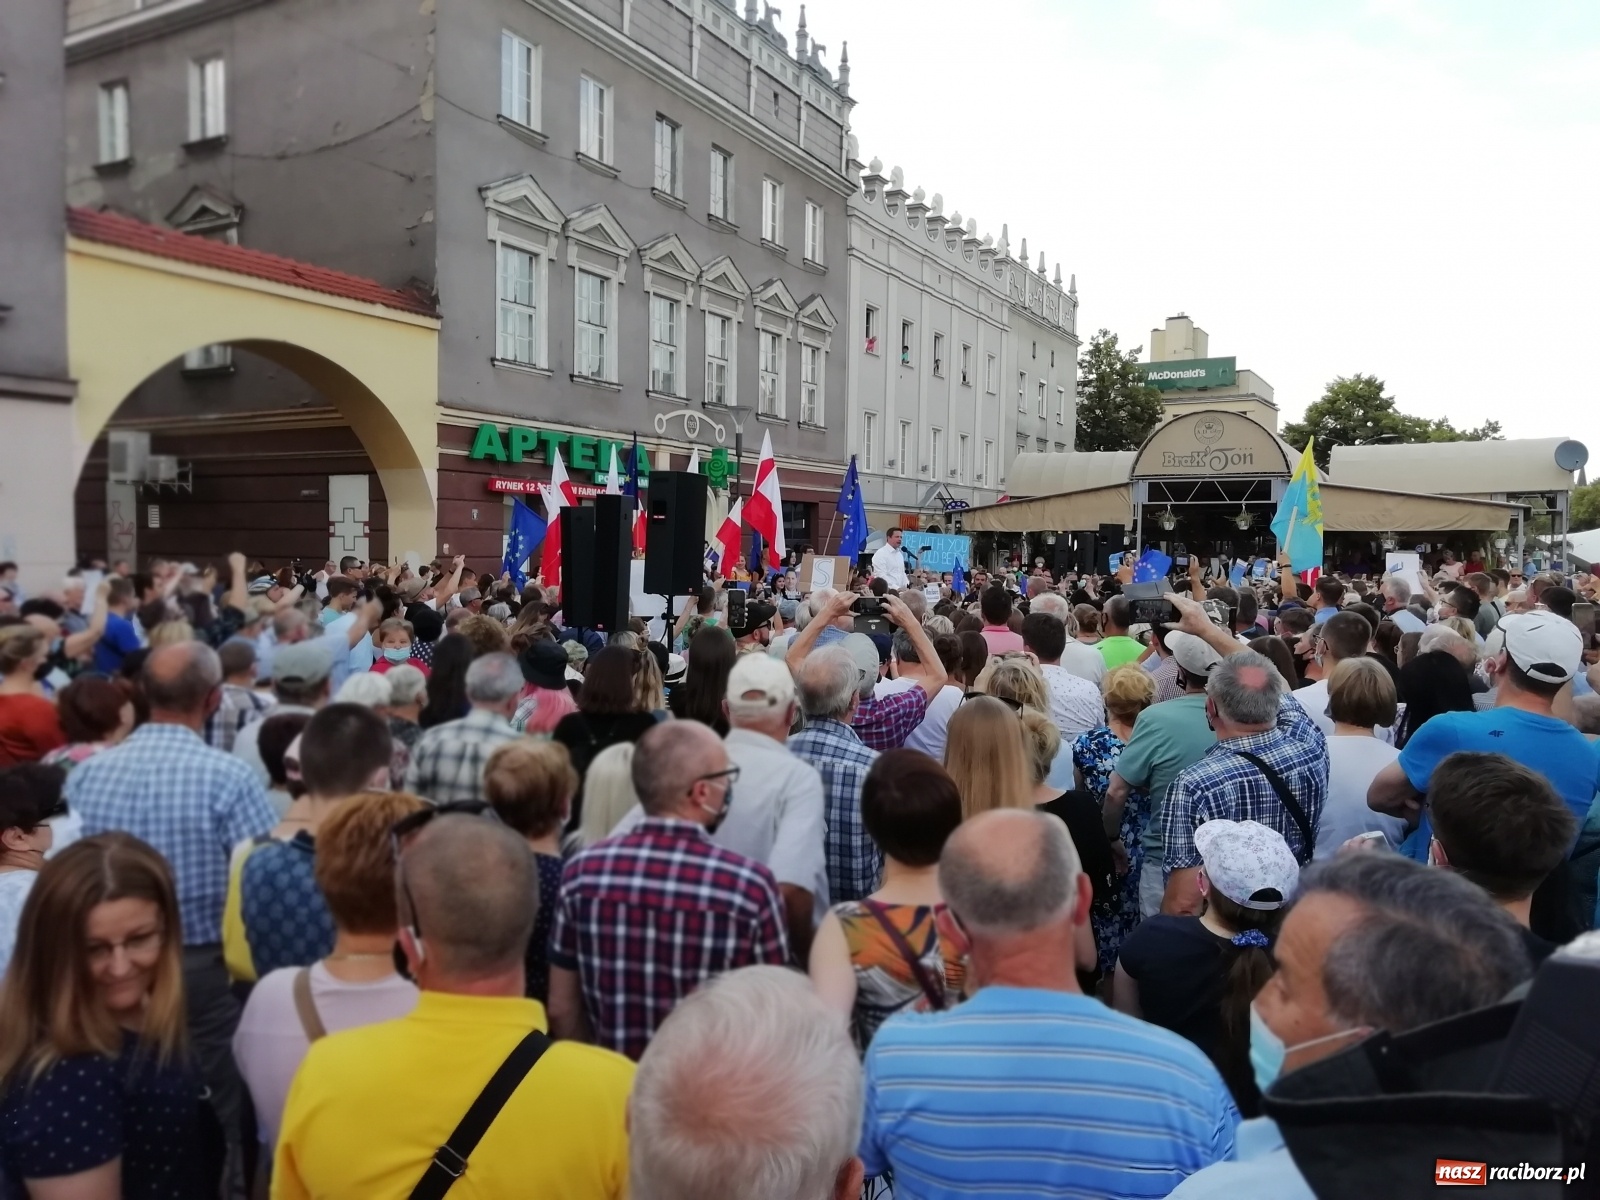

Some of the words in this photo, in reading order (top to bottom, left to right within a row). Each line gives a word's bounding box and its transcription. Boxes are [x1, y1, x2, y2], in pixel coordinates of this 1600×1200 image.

[1147, 368, 1206, 381] McDonald's
[469, 423, 652, 477] APTEKA
[495, 480, 524, 491] RYNEK
[525, 482, 535, 492] 12
[918, 535, 944, 551] WITH
[948, 538, 968, 553] YOU
[814, 558, 832, 588] S
[1488, 730, 1504, 738] 4F
